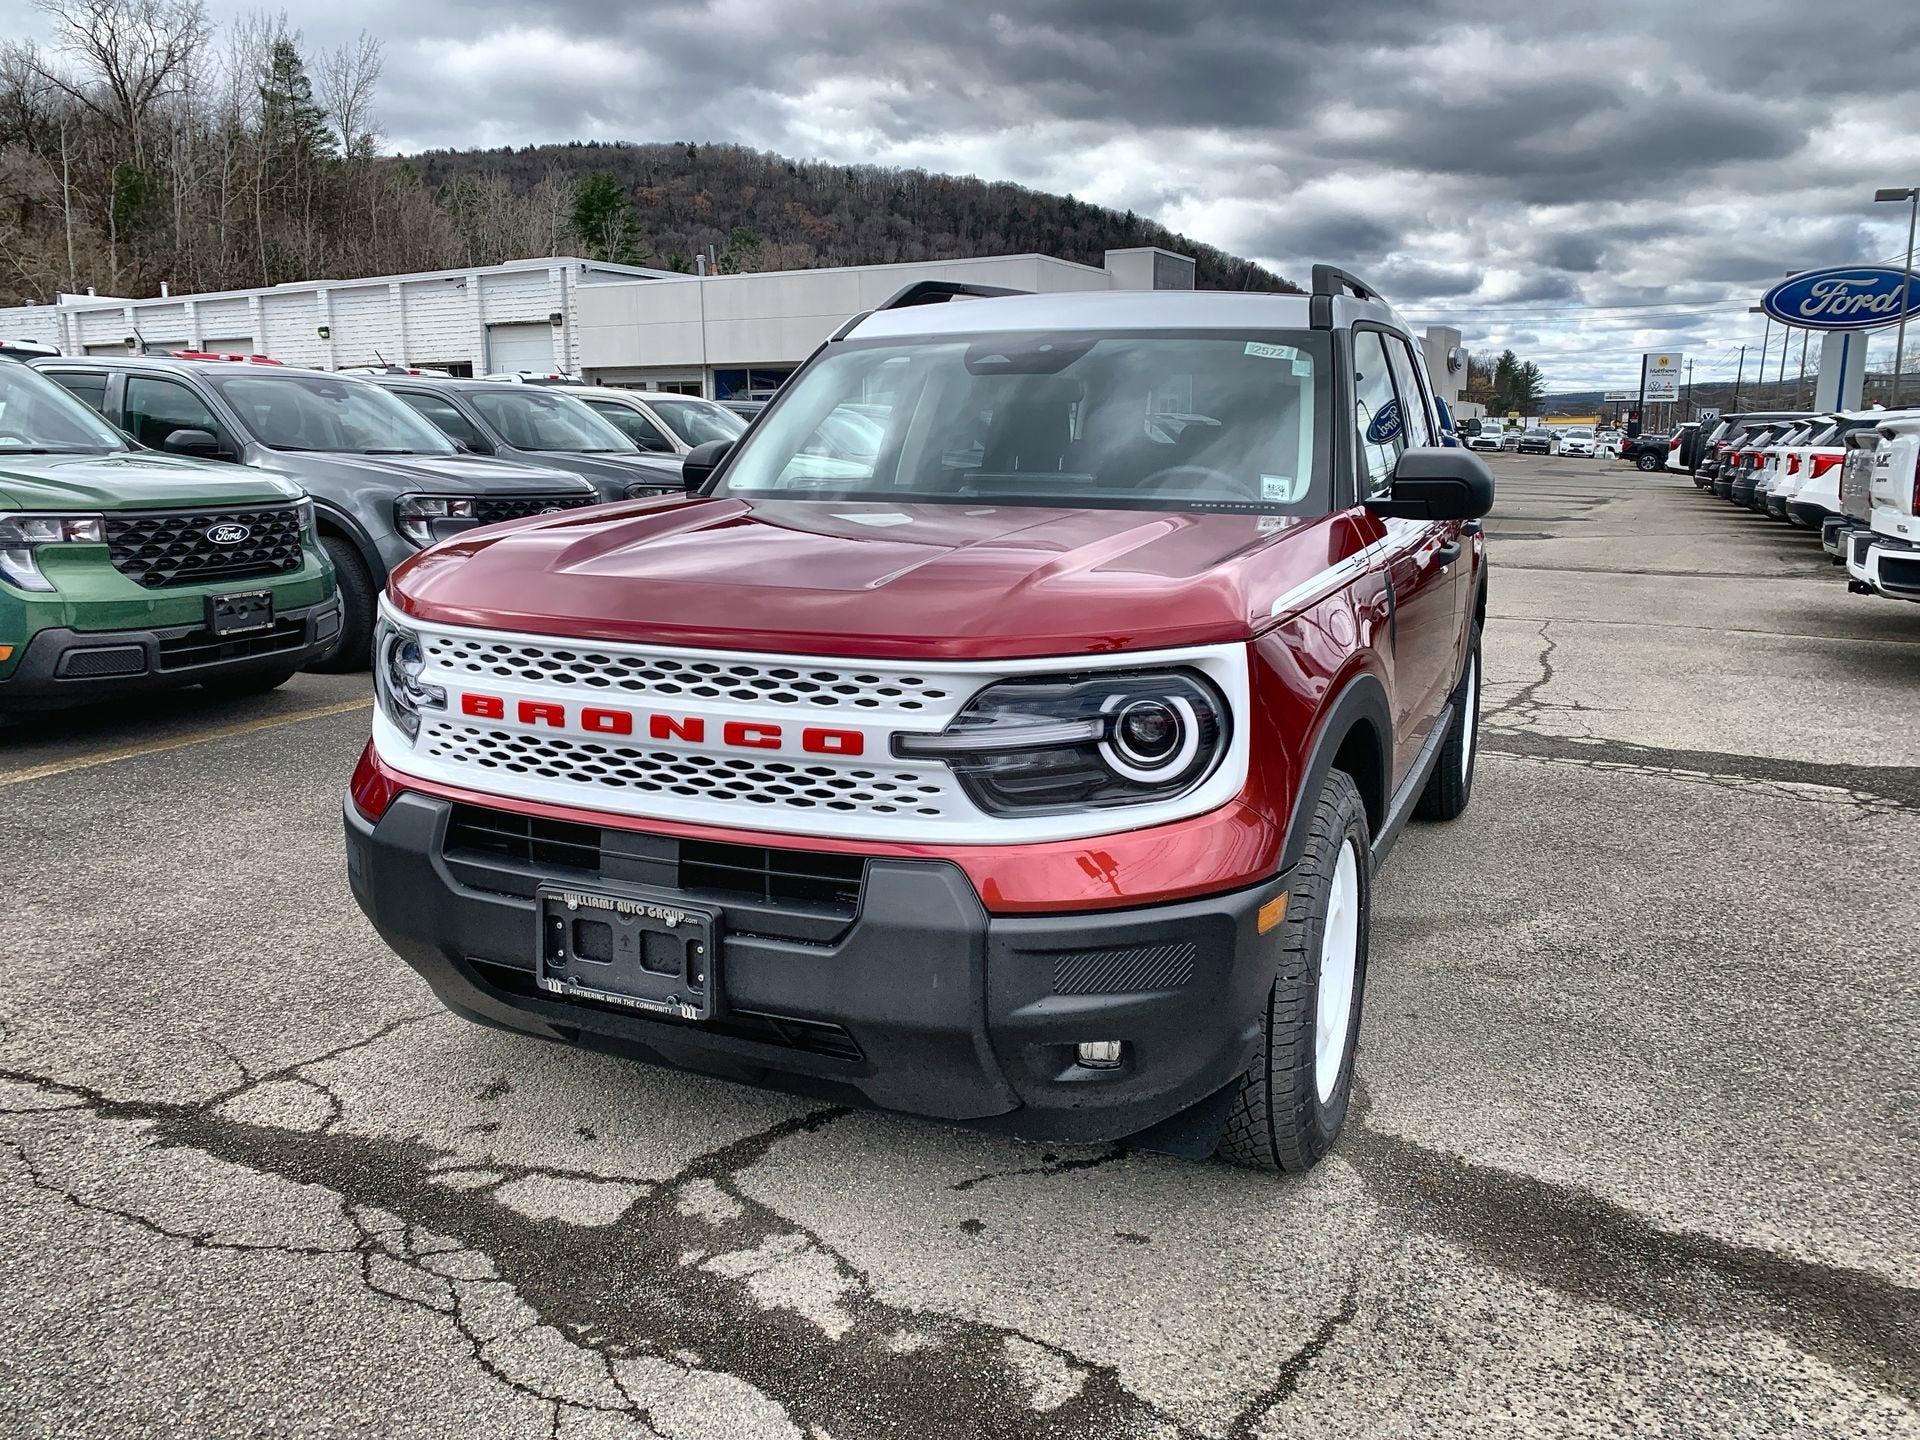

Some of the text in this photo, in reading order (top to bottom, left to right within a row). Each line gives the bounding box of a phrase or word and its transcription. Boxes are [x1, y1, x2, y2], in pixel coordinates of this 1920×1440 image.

[1800, 278, 1905, 316] Ford
[1253, 345, 1285, 357] 2572
[216, 527, 241, 541] Ford
[461, 692, 864, 756] BRONCO
[617, 901, 645, 916] AUTO
[569, 988, 673, 1014] PARTNERING WITH THE COMMUNITY
